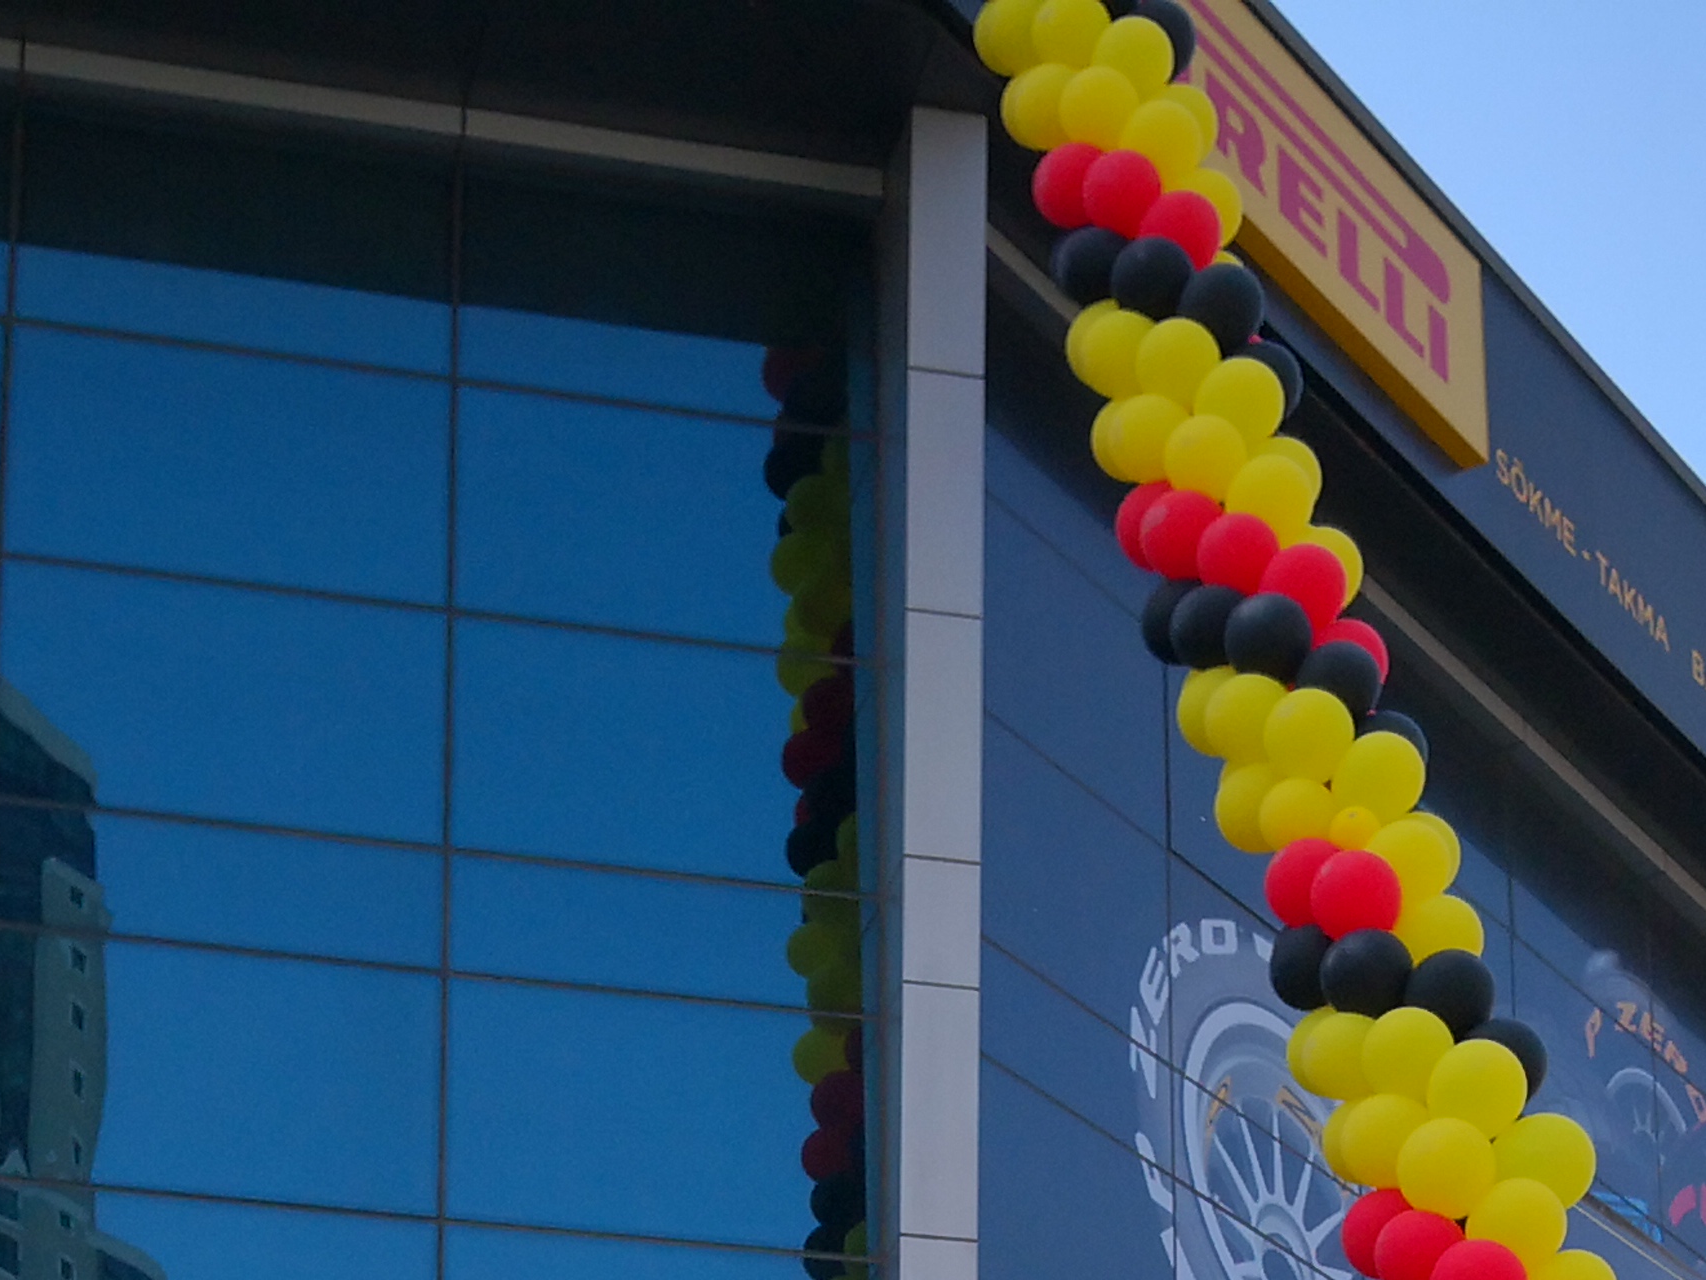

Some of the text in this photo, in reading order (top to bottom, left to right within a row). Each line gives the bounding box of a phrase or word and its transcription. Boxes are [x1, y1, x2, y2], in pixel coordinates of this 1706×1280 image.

[1186, 0, 1450, 384] RELLI
[1496, 449, 1577, 557] SÖKME
[1596, 551, 1671, 652] TAKMA
[1129, 918, 1238, 1099] ZERO
